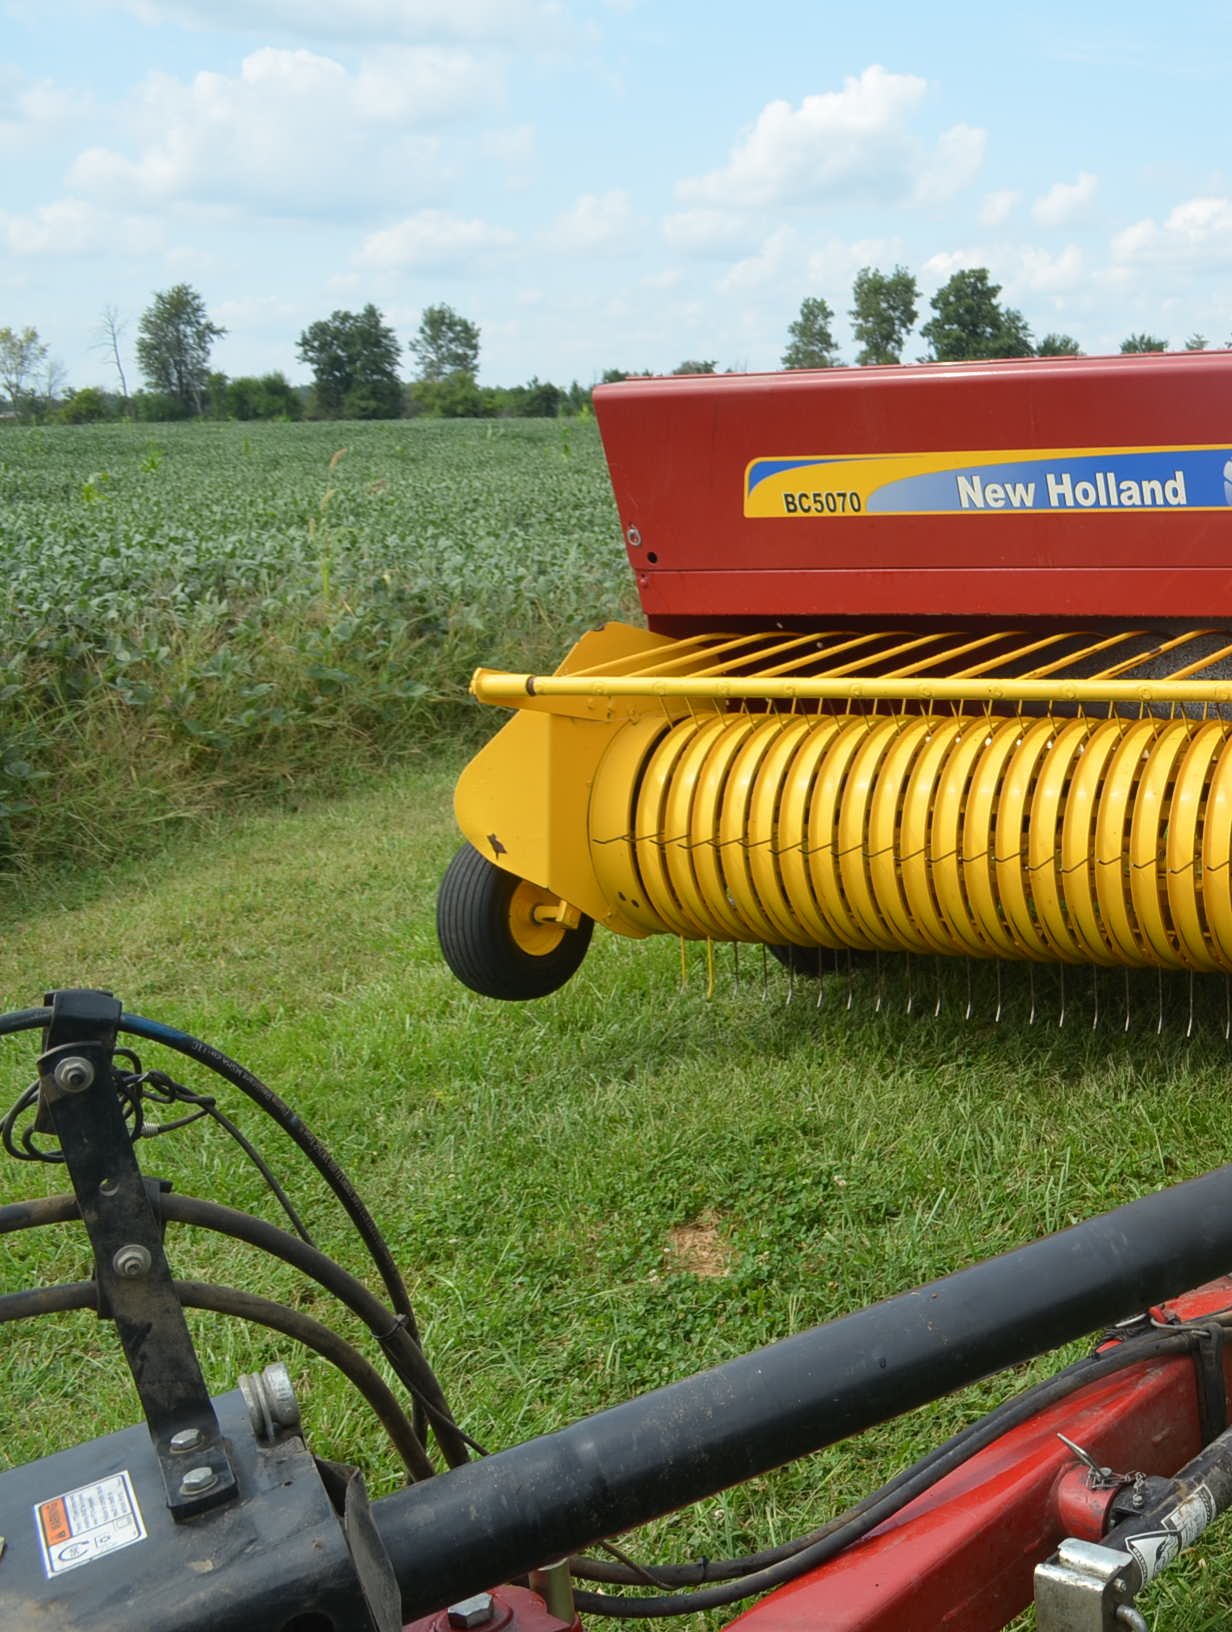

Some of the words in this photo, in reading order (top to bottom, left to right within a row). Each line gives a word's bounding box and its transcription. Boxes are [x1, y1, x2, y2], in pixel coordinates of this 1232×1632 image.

[783, 492, 862, 513] BC5070
[956, 475, 1036, 509] New
[1045, 470, 1188, 507] Holland
